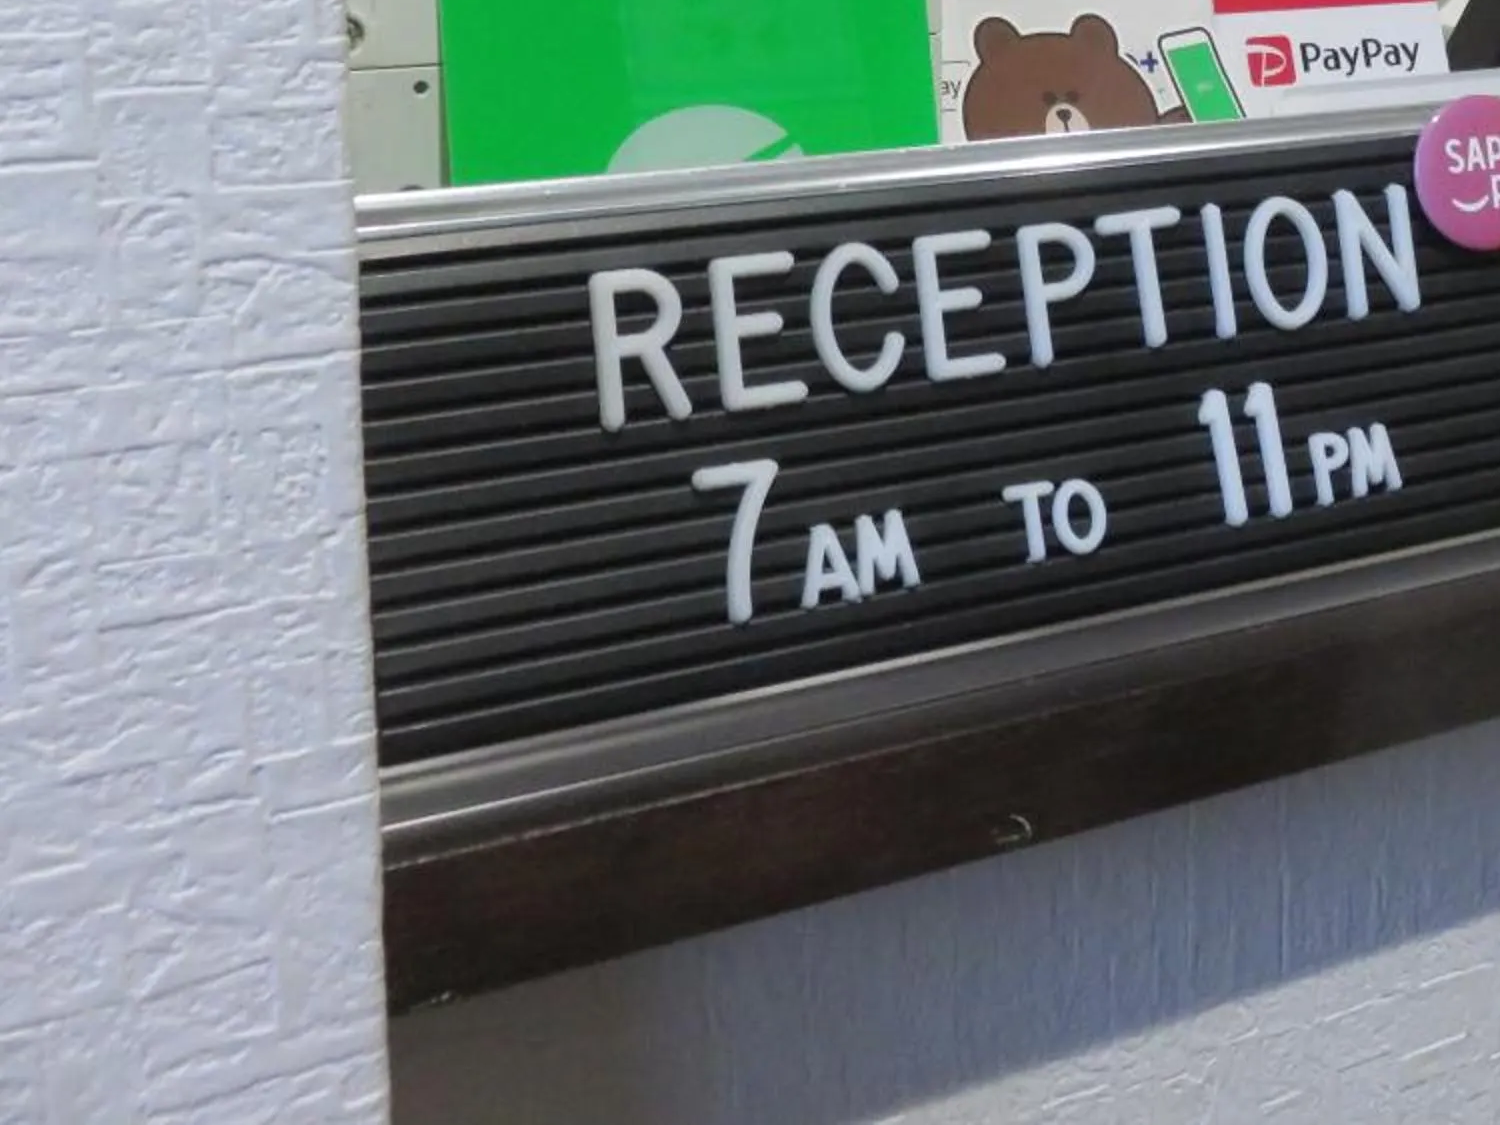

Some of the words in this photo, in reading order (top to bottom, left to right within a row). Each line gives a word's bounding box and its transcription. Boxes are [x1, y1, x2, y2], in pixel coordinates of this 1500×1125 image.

[940, 79, 962, 100] ay
[1300, 38, 1419, 78] PayPay
[589, 183, 1421, 431] RECEPTION
[691, 459, 779, 624] 7
[801, 509, 921, 609] AM
[1002, 478, 1108, 564] TO
[1198, 381, 1293, 527] 11
[1307, 422, 1403, 507] PM
